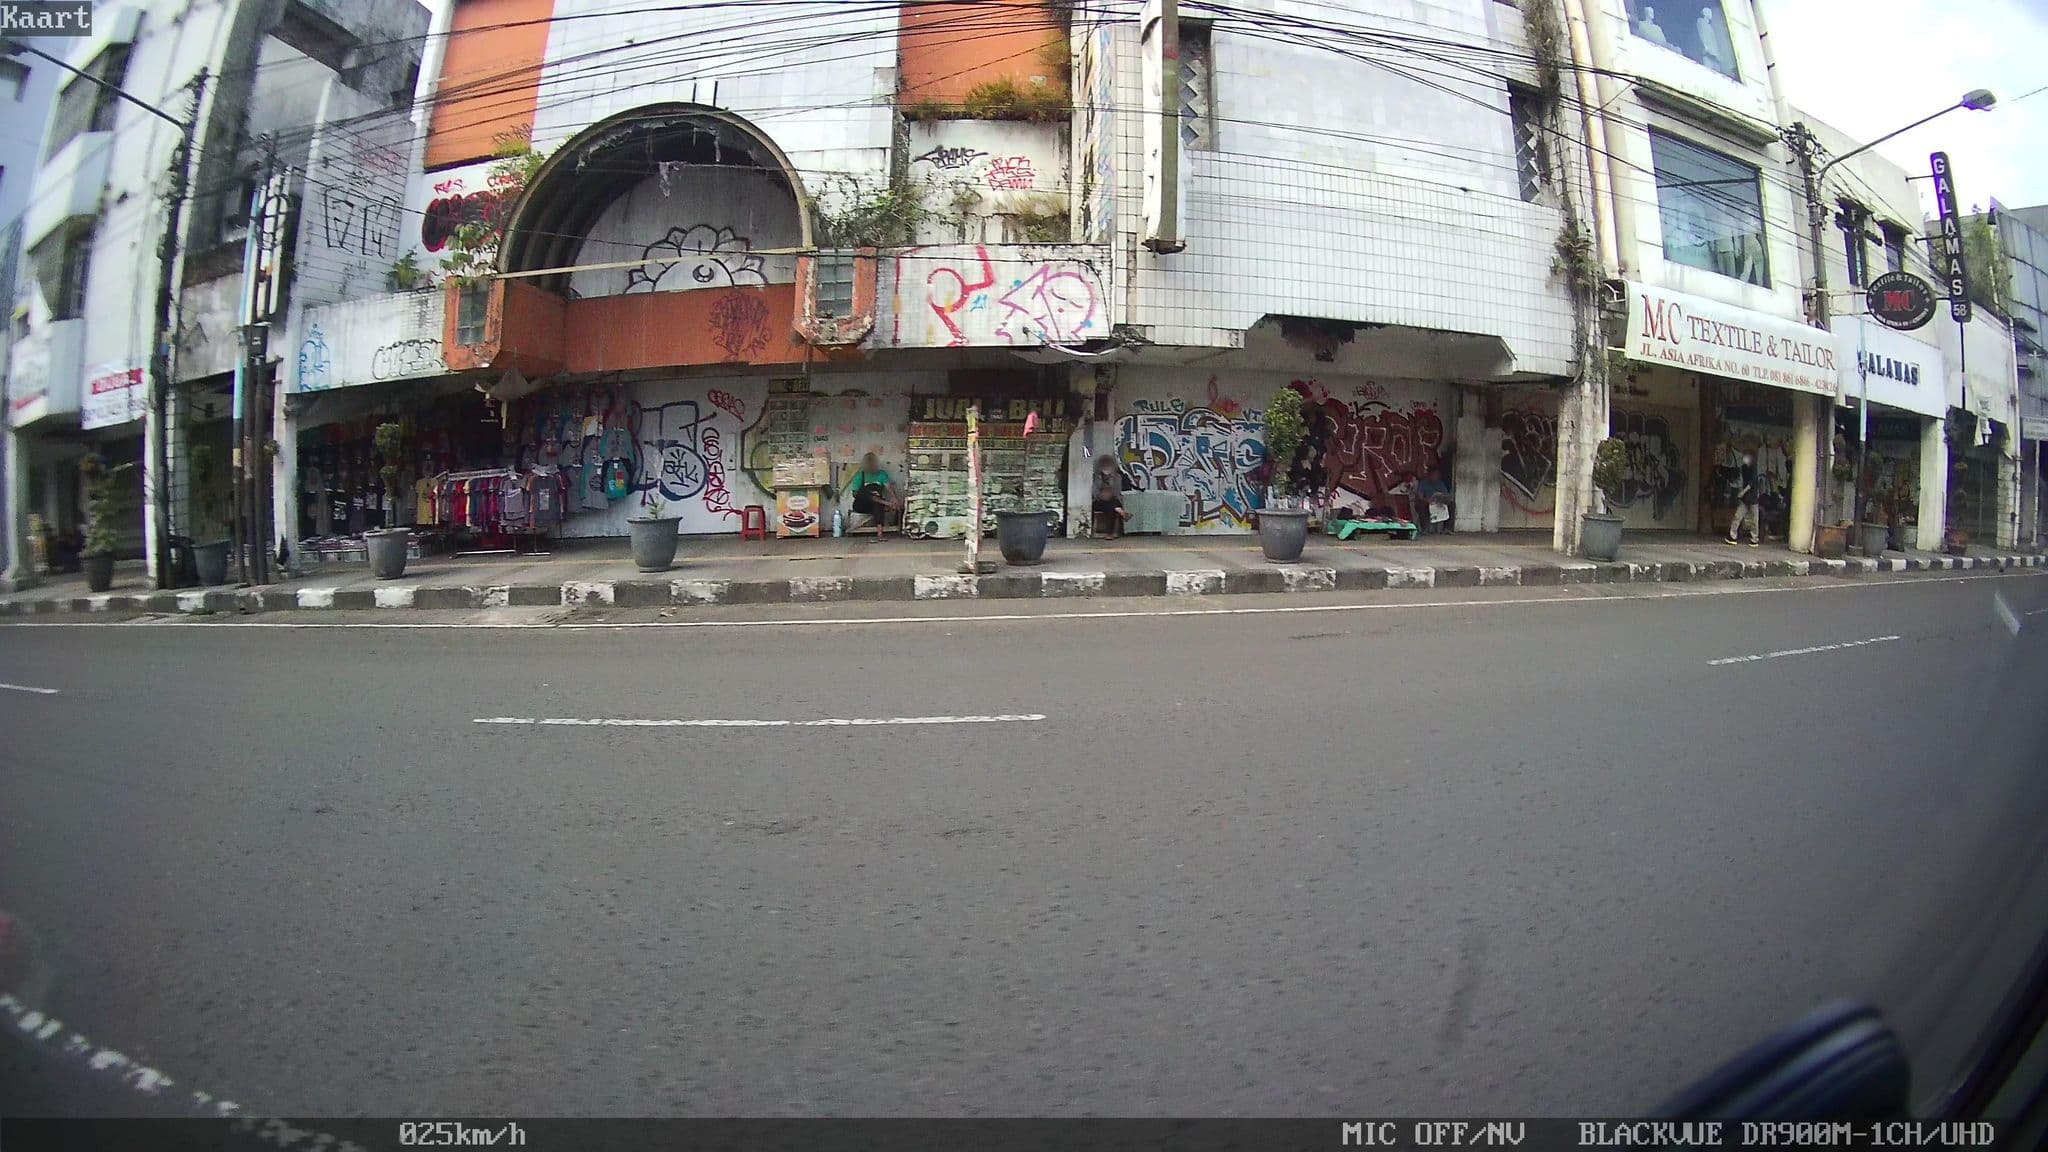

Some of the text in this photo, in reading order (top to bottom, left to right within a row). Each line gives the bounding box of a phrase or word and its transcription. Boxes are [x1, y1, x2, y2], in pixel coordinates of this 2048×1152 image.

[1933, 158, 1963, 297] GALAMAS
[1641, 294, 1837, 371] MC TEXTILE & TAILOR
[1953, 304, 1967, 316] 58
[1640, 343, 1657, 358] JL.
[1660, 348, 1685, 364] ASIA
[1686, 353, 1723, 372] AFRIKA
[1723, 361, 1740, 375] NO.
